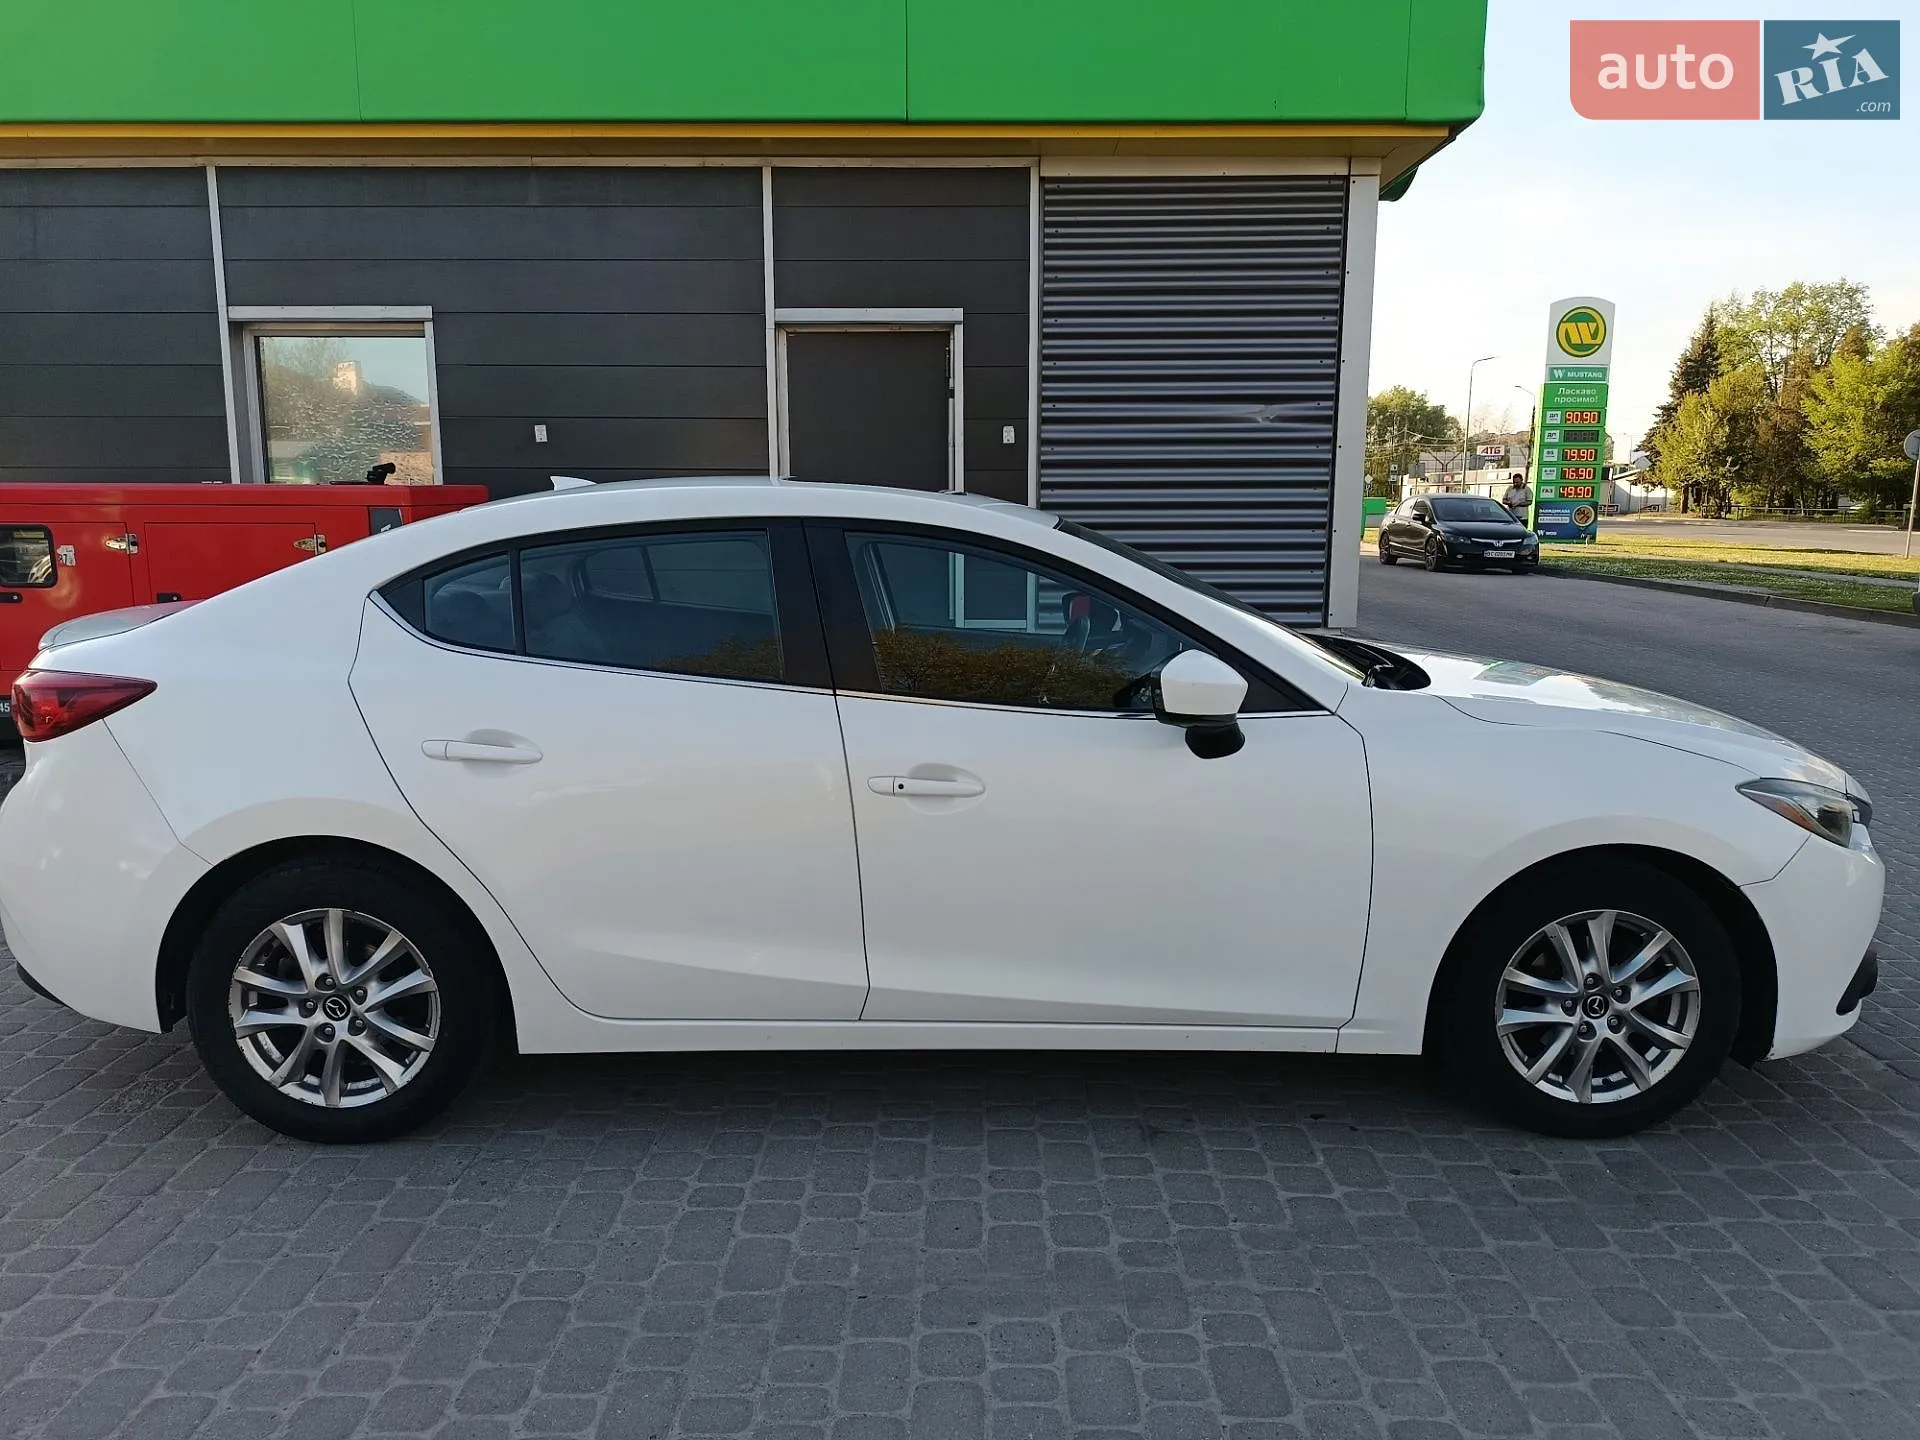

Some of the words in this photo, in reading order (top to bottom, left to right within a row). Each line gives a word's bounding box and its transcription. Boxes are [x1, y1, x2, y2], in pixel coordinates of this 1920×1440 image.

[1558, 387, 1597, 395] Ласкаво
[1554, 395, 1598, 404] просимо!
[1566, 411, 1598, 424] 90.90
[1564, 449, 1595, 461] 79.90
[1562, 468, 1594, 480] 76.90
[1560, 486, 1592, 498] 49.90
